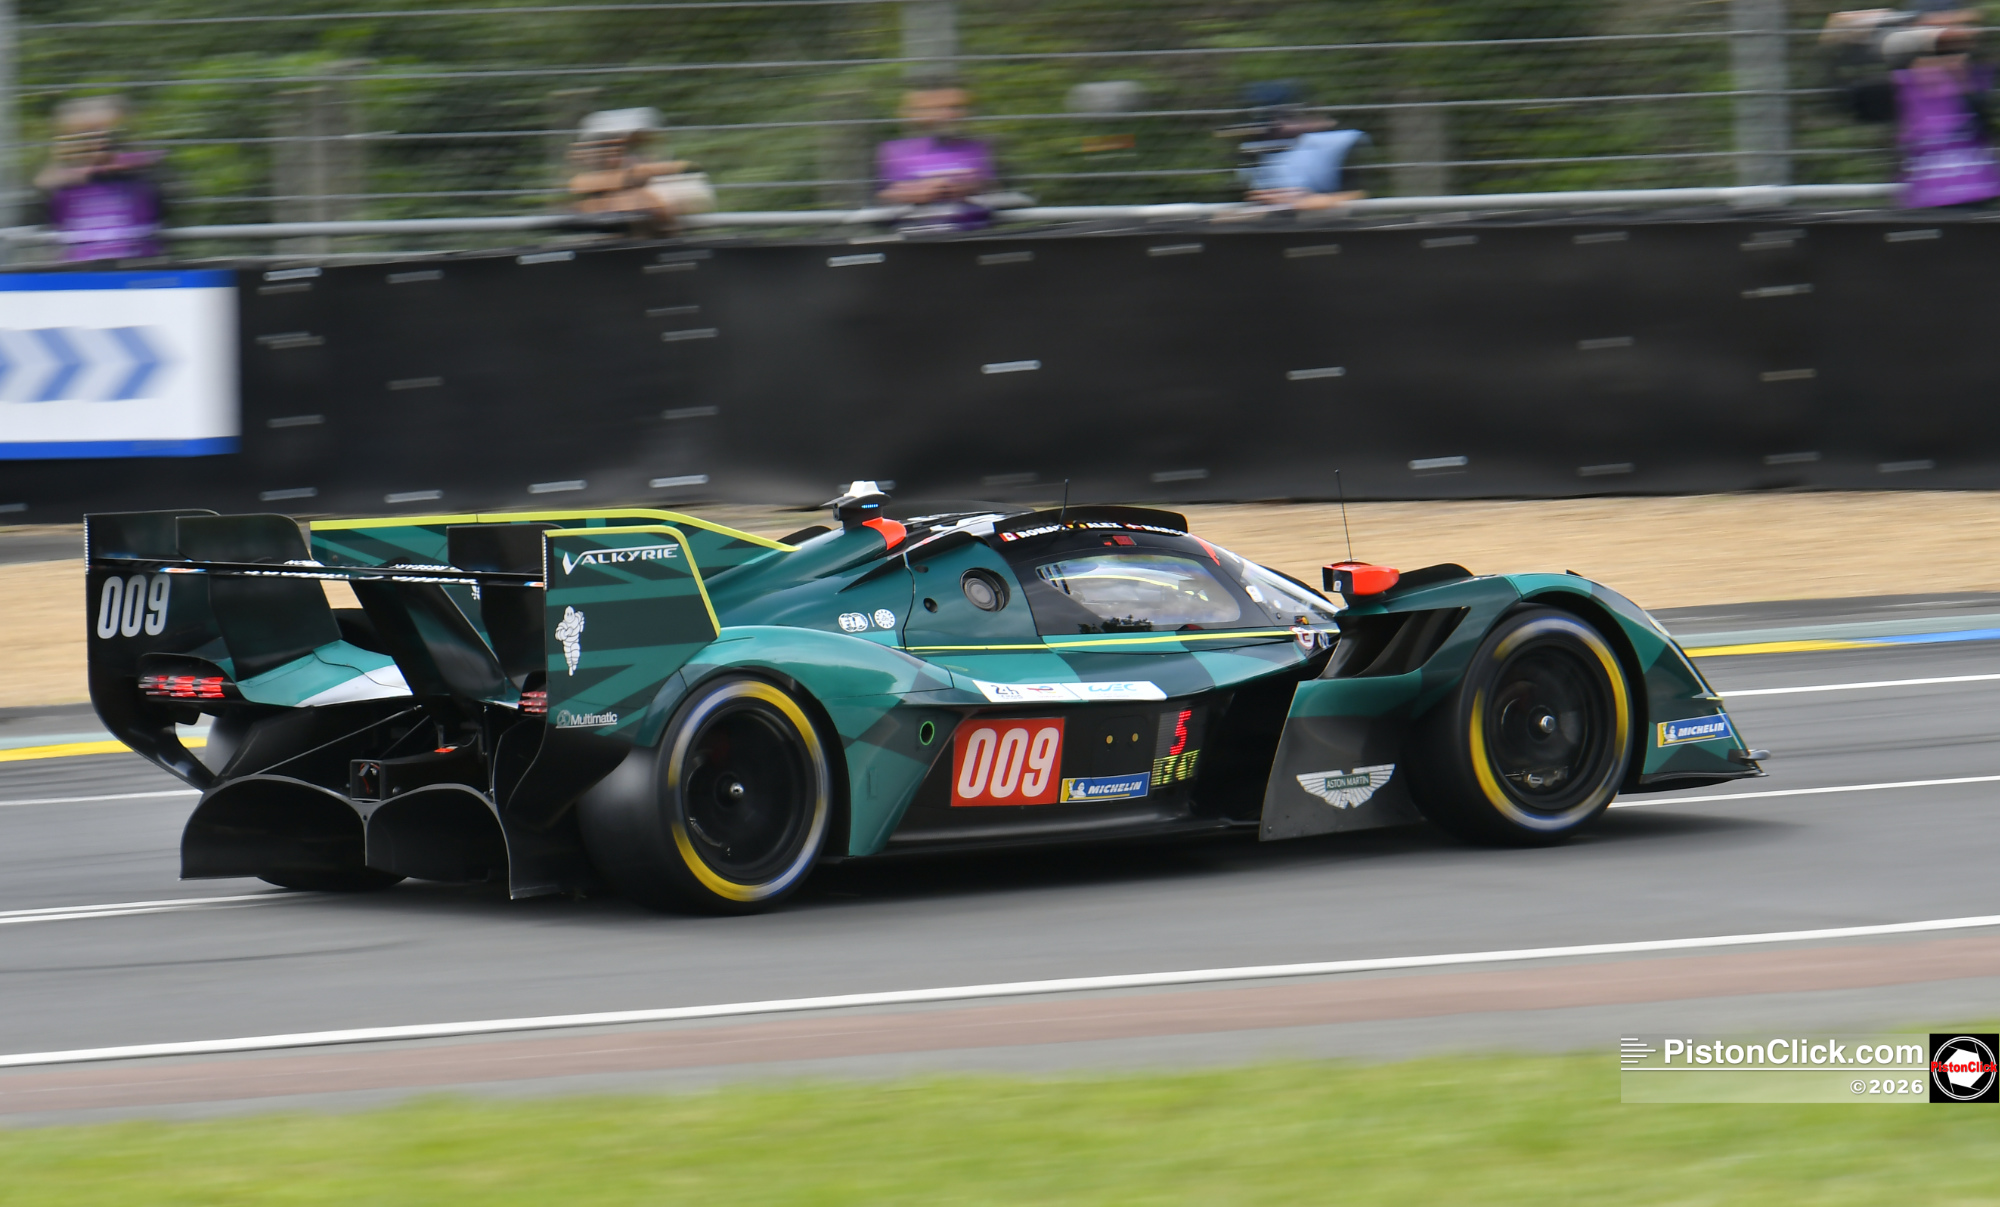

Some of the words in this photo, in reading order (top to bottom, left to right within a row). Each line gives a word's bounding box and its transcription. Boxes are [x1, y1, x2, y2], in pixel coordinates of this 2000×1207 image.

[562, 544, 679, 575] VALKYRIE
[97, 574, 171, 639] 009
[1088, 683, 1137, 692] WEC
[570, 711, 618, 726] Multimatic
[1170, 709, 1192, 755] 5
[1678, 722, 1725, 737] MICHELIN
[957, 727, 1060, 798] 009
[1088, 781, 1142, 794] MICHELIN
[1326, 779, 1346, 788] ASTON
[1346, 776, 1369, 785] MARTIN
